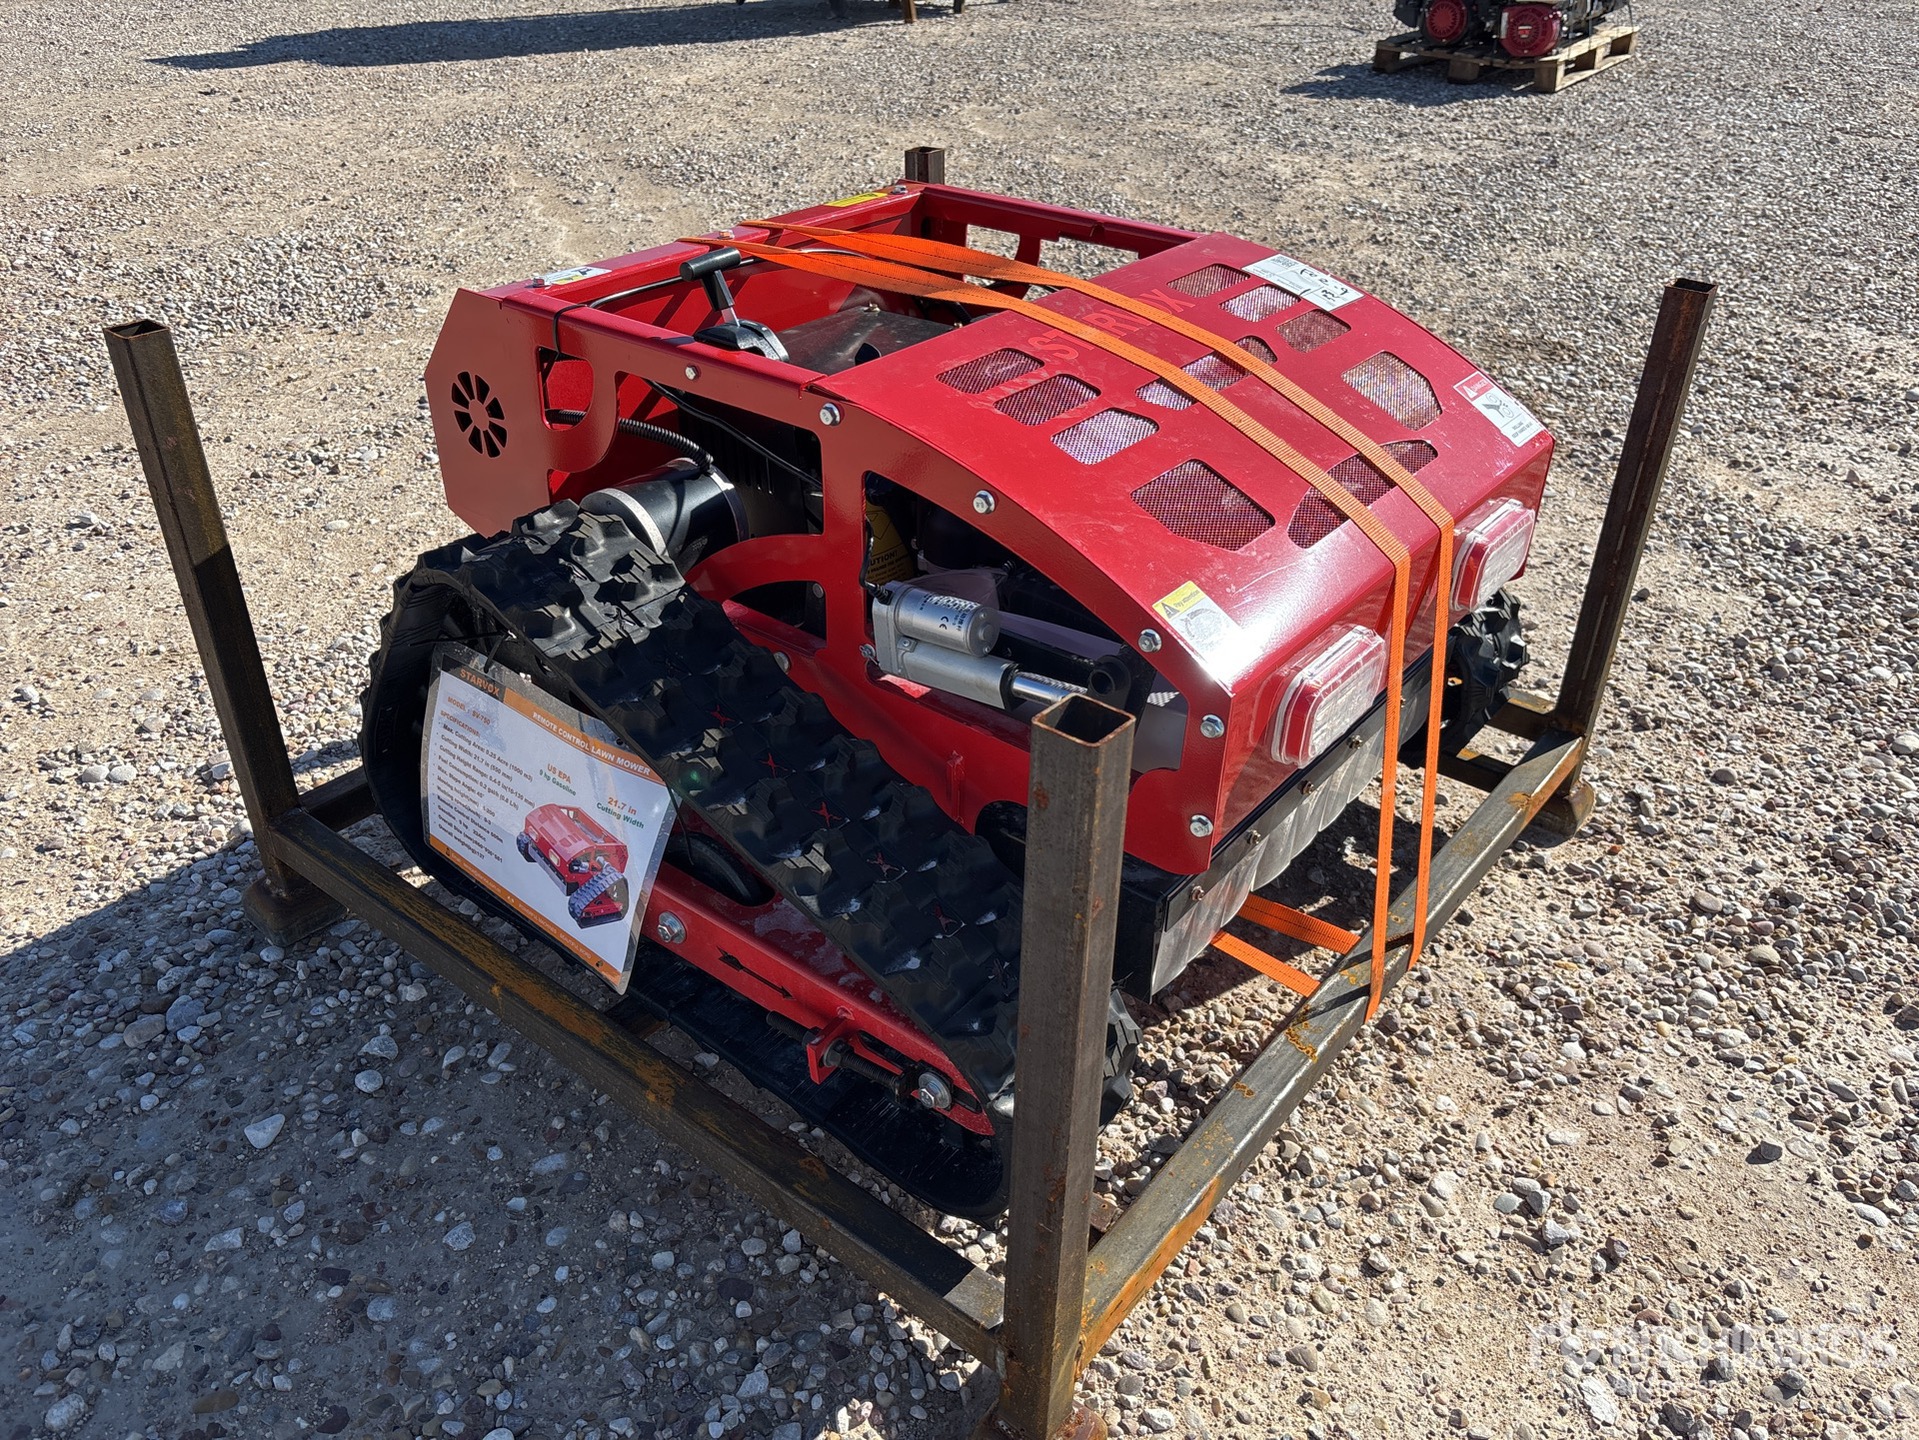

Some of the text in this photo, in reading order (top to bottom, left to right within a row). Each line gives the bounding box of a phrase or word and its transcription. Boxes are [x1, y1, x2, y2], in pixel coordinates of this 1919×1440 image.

[1028, 288, 1196, 360] STRVX
[870, 549, 898, 566] UTION!
[460, 668, 500, 697] STARVOX
[448, 696, 466, 710] MODEL
[441, 734, 457, 748] Cutting
[474, 754, 483, 763] 21.7
[455, 731, 471, 745] Cutting
[497, 756, 508, 766] Acre
[532, 712, 651, 776] REMOTE CONTROL LAWN MOWER
[440, 745, 455, 759] Cutting
[457, 756, 471, 769] Height
[544, 772, 551, 782] hp
[552, 776, 576, 796] Gasoline
[547, 763, 572, 784] US EPA
[596, 802, 645, 829] Cutting Width
[608, 797, 637, 816] 21.7 in
